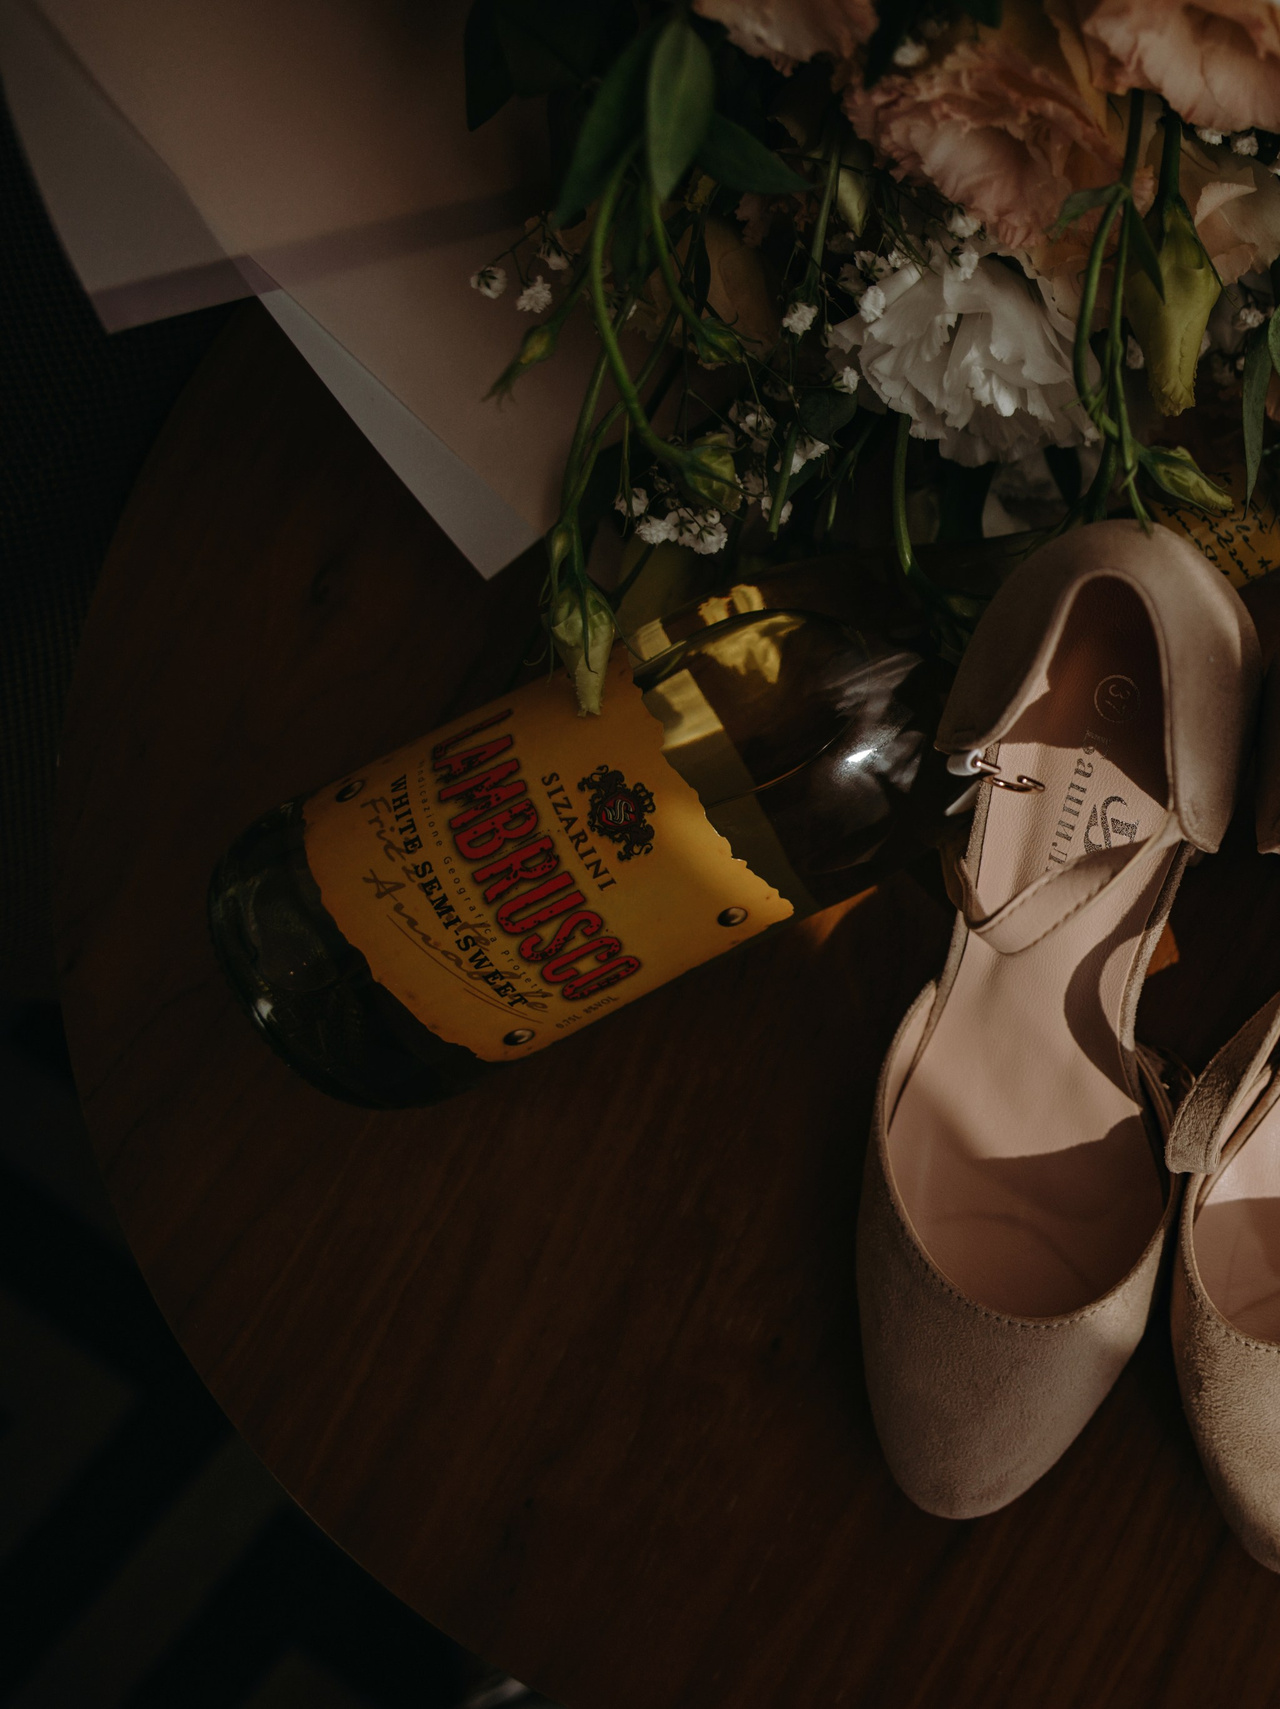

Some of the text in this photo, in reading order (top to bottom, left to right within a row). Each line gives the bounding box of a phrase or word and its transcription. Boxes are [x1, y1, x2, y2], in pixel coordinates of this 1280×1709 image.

[390, 773, 529, 1008] WHITE SEMI-SWEET
[432, 708, 641, 1001] LAMBRUSCO
[443, 856, 498, 944] Geografica
[541, 772, 617, 892] SIZARINI
